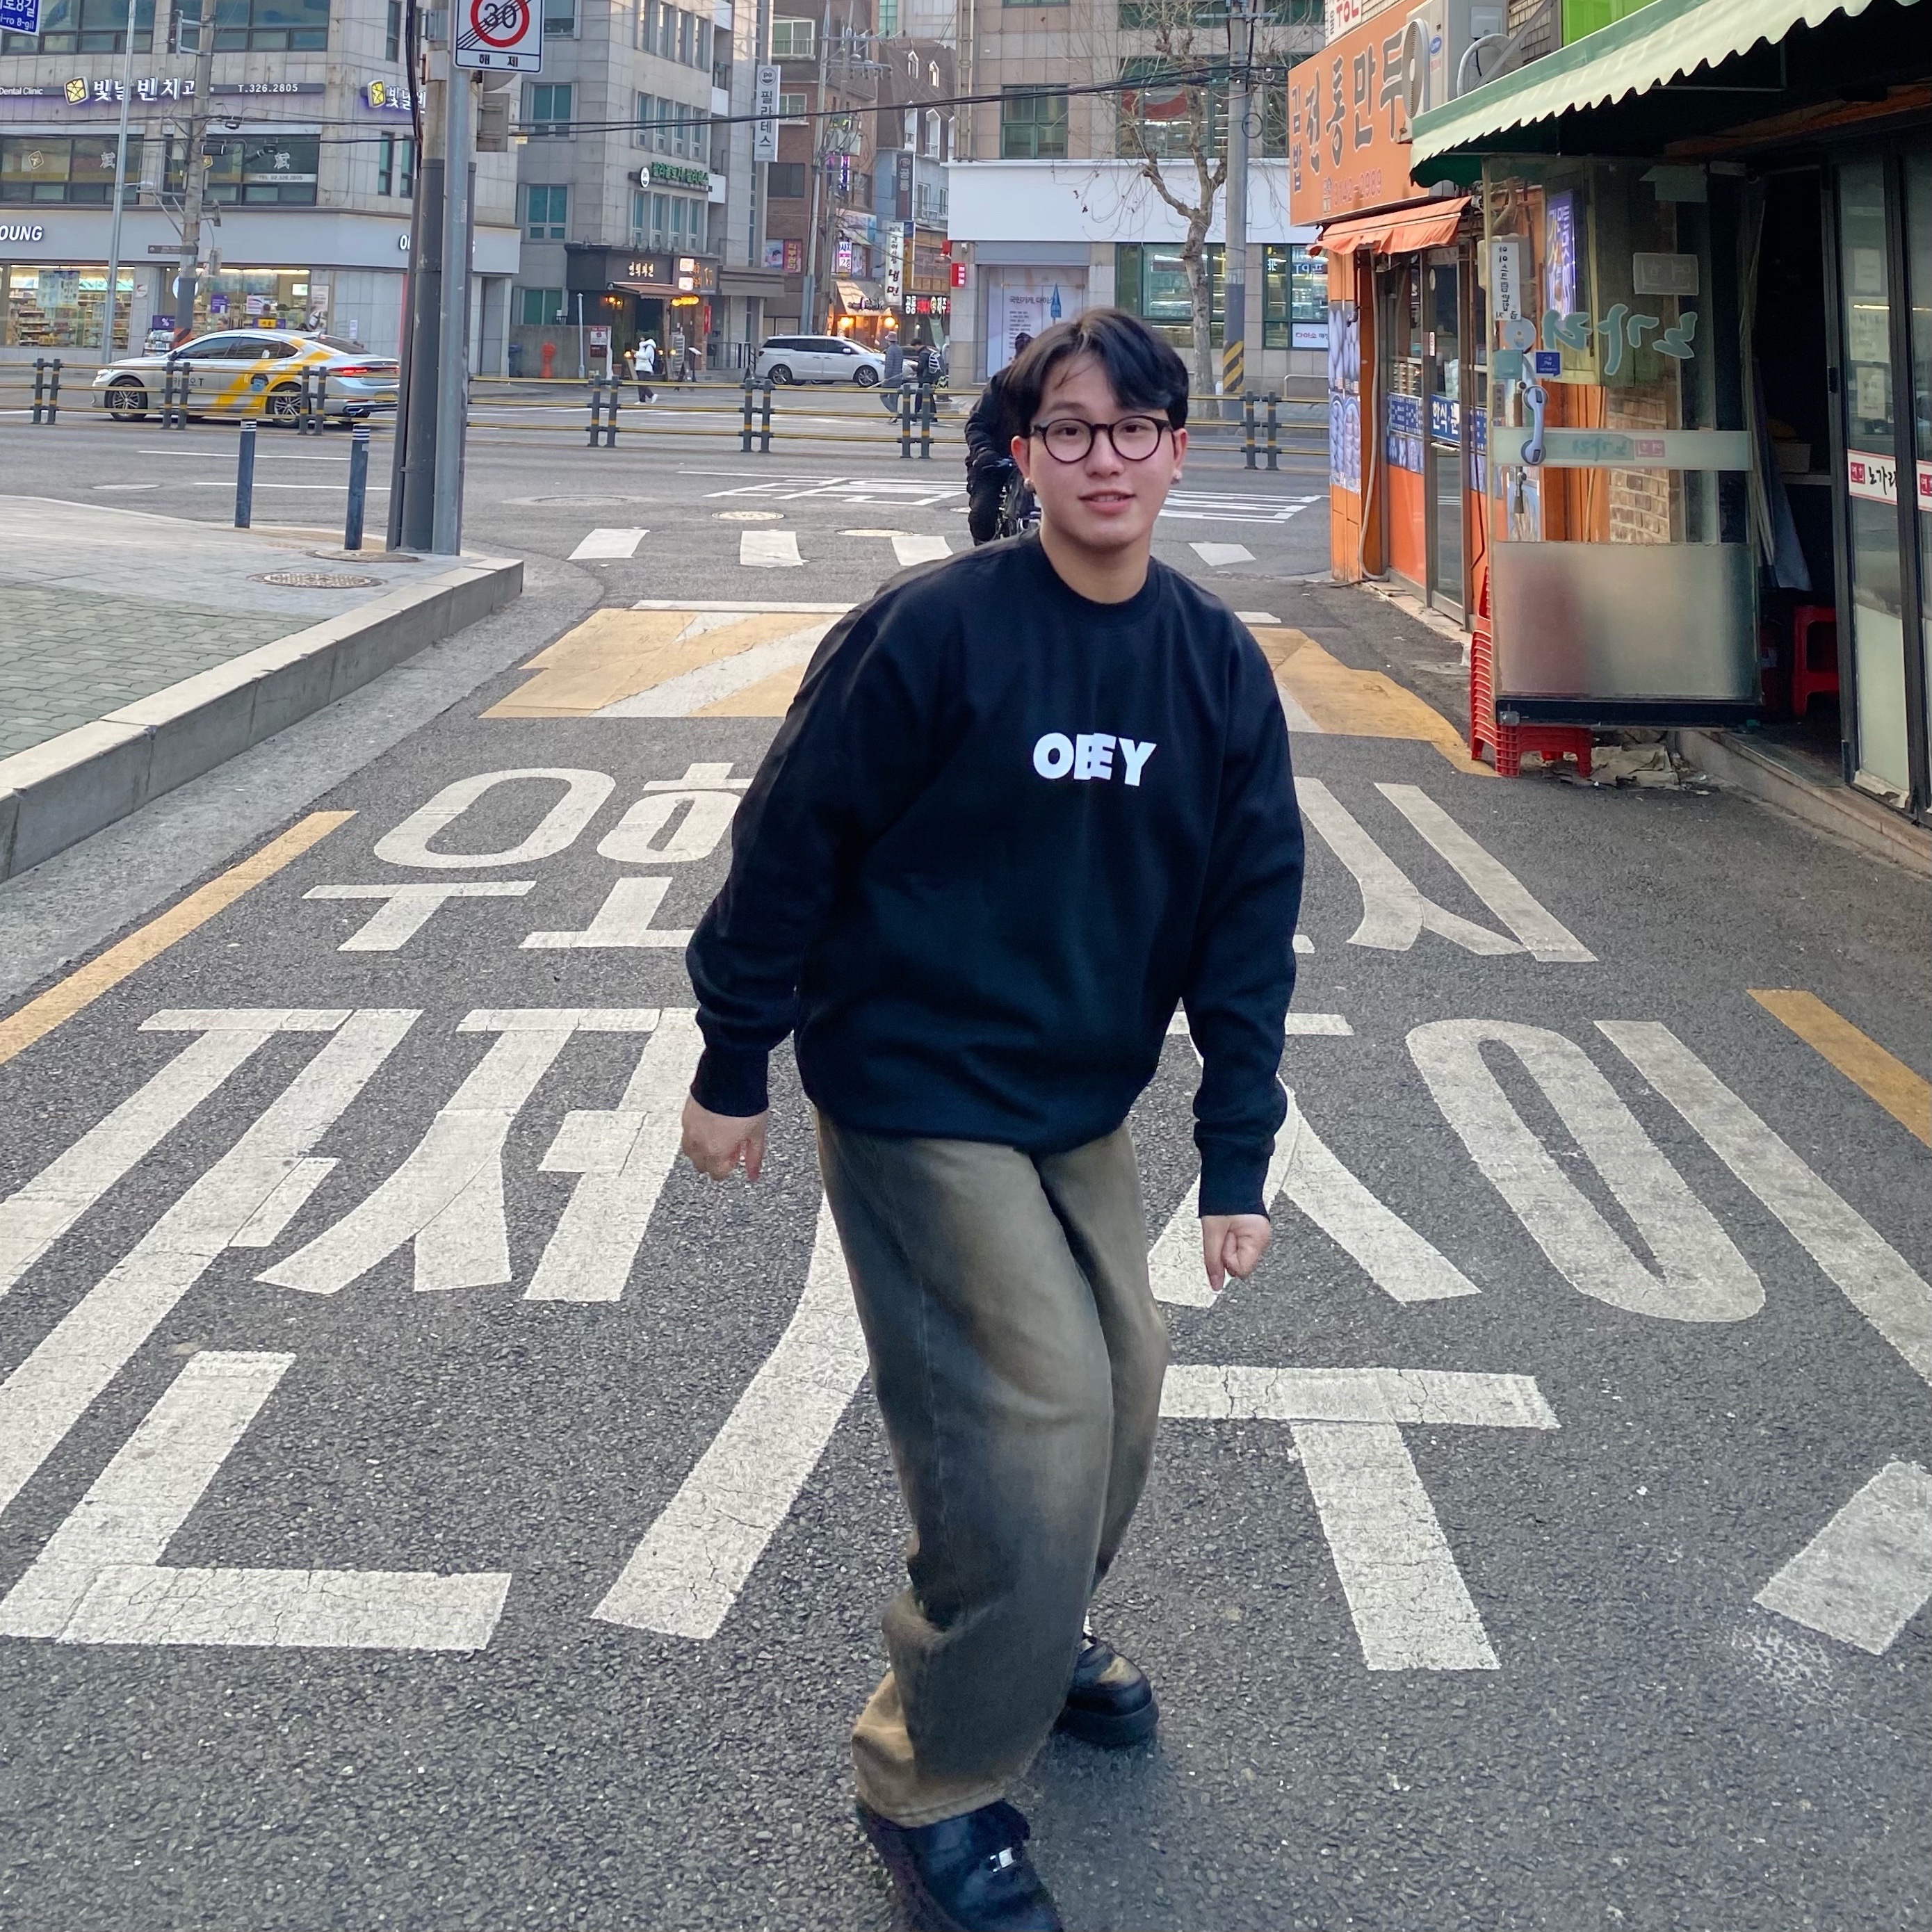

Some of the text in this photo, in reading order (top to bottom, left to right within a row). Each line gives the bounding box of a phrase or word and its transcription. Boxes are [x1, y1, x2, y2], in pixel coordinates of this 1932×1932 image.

[17, 17, 34, 30] 8-gil
[485, 3, 517, 29] 30
[23, 87, 43, 95] Clinic
[238, 83, 298, 93] T.326.2805
[759, 90, 772, 147] 필라테스
[886, 269, 900, 297] 냉면
